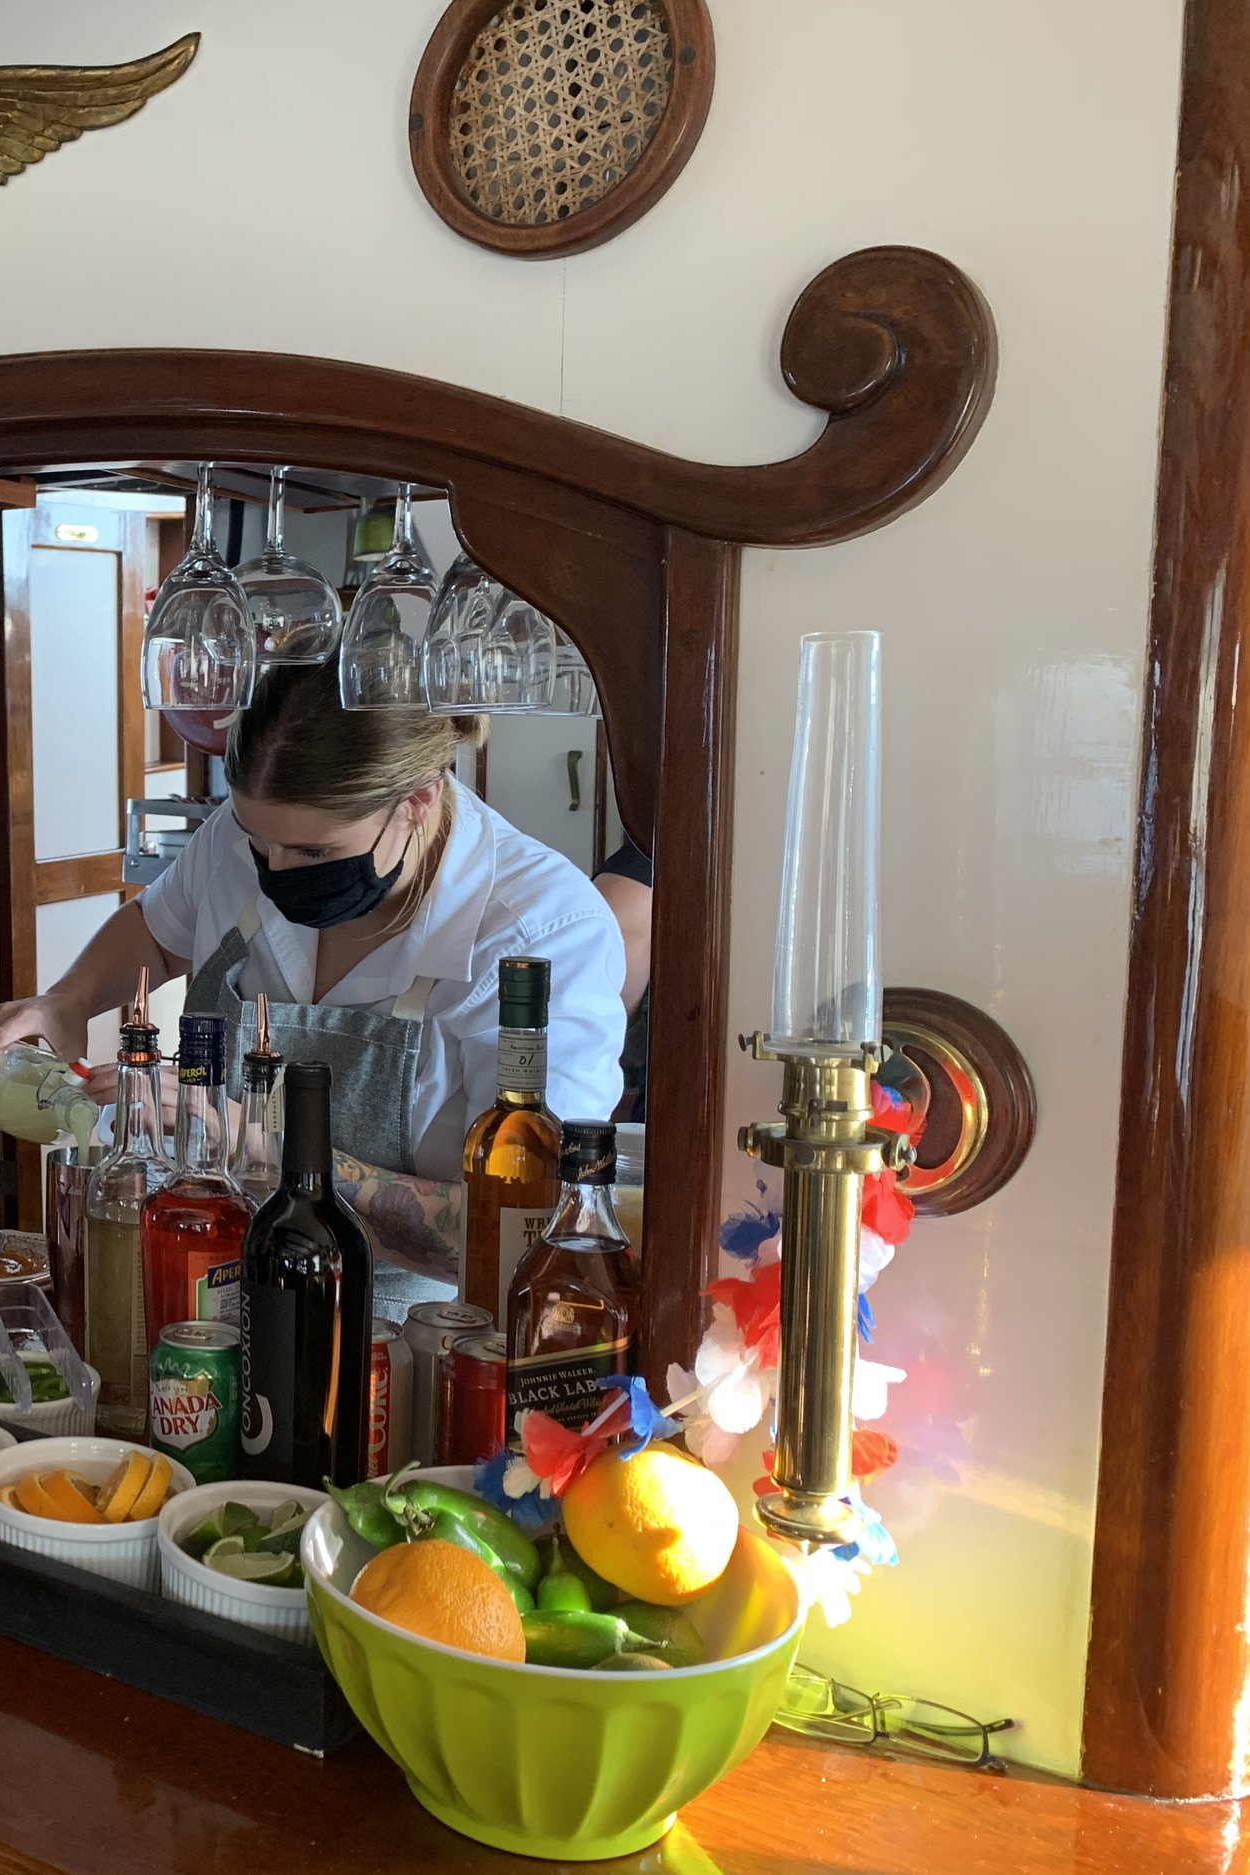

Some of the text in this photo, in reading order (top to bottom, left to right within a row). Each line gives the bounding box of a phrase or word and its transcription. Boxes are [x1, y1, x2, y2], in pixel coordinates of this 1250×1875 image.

[520, 1374, 558, 1388] JOHNNIE
[510, 1385, 560, 1405] BLACK
[159, 1414, 200, 1436] DRY
